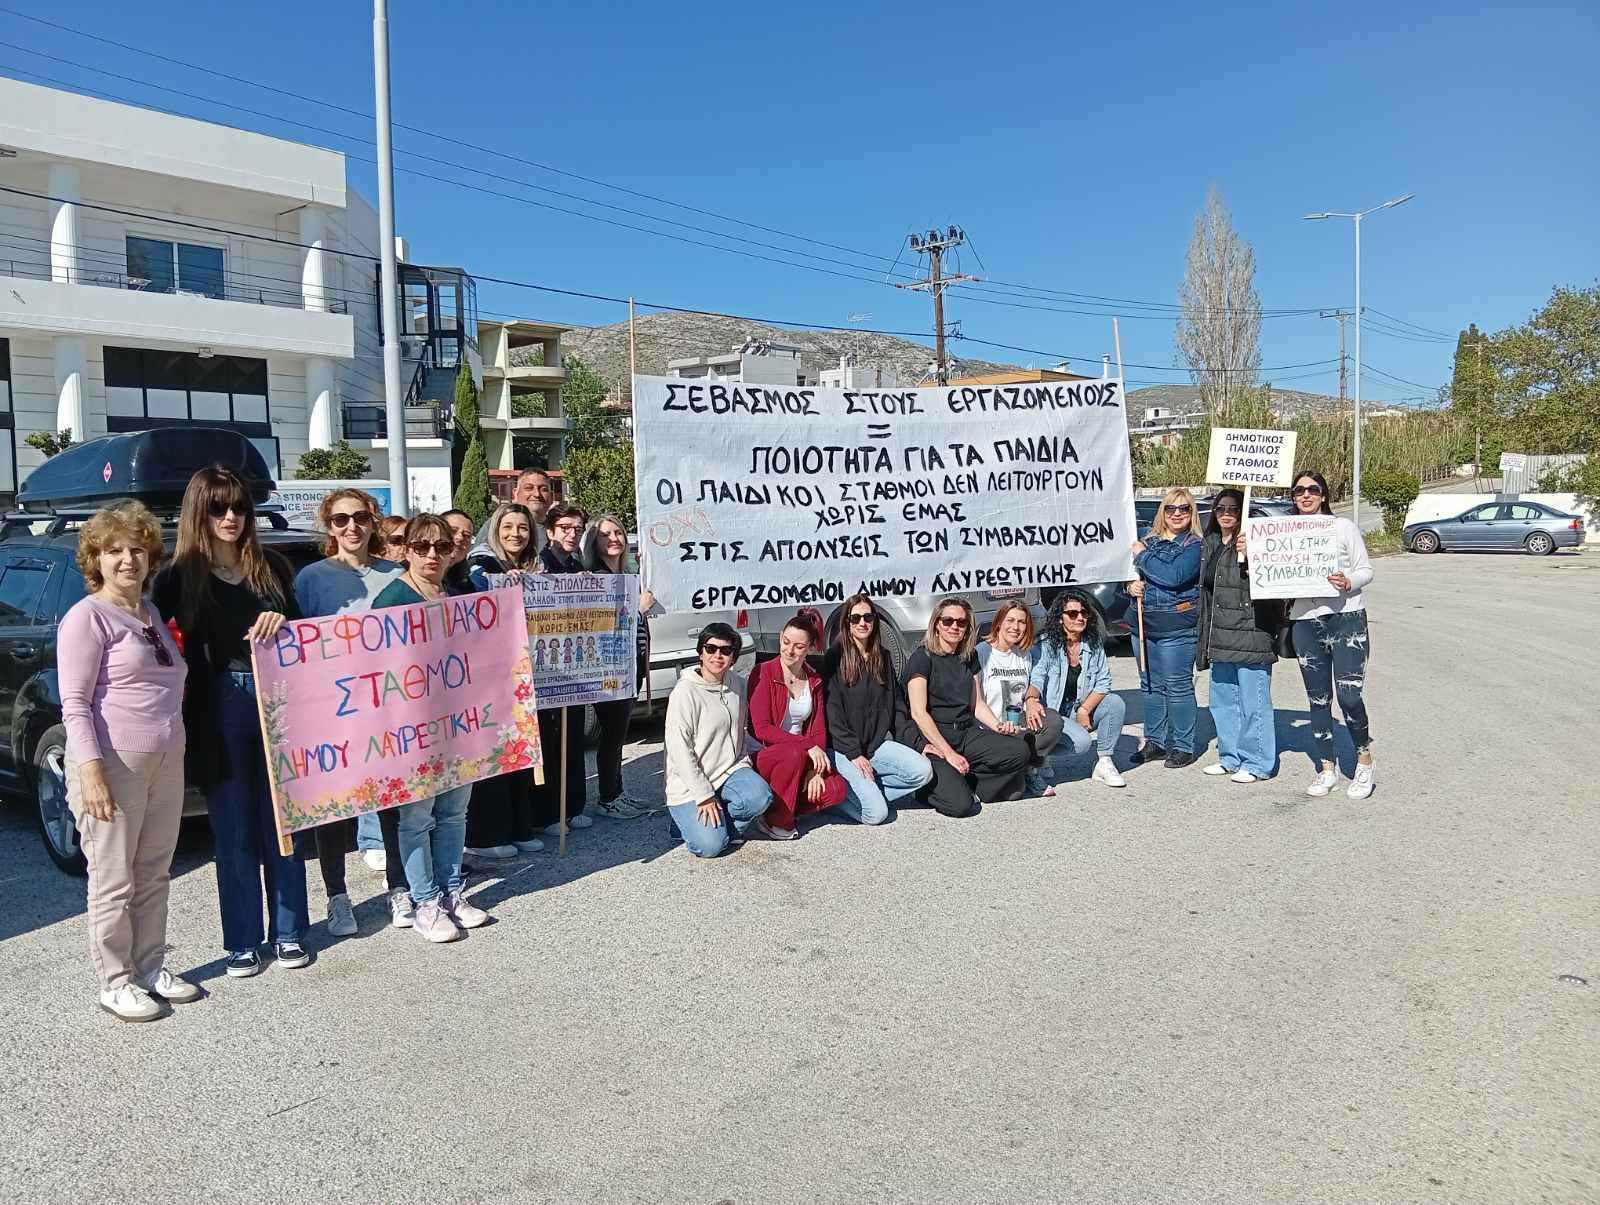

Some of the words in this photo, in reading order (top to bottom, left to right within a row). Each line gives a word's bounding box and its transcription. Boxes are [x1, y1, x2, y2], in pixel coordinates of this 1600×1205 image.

[663, 384, 820, 415] ΣΕΒΑΣΜΟΣ
[843, 392, 924, 415] ΣΤΟΥΣ
[947, 383, 1119, 413] ΕΡΓΑΖΟΜΕΝΟΥΣ
[1225, 433, 1285, 444] ΔΗΜΟΤΙΚΟΣ
[1229, 444, 1281, 455] ΠΑΙΔΙΚΟΣ
[750, 446, 893, 474] ΠΟΙΟΤΗΤΑ
[904, 445, 945, 472] ΓΙΑ
[948, 443, 984, 467] ΤΑ
[993, 435, 1079, 463] ΠΑΙΔΙΑ
[1225, 457, 1280, 469] ΣΤΑΘΜΟΣ
[656, 478, 682, 505] ΟΙ
[696, 479, 826, 508] ΠΑΙΔΙΚΟΙ
[839, 478, 936, 501] ΣΤΑΘΜΟΙ
[943, 470, 980, 495] ΔΕΝ
[987, 466, 1104, 492] ΛΕΙΤΟΥΡΓΟΥΝ
[1222, 472, 1276, 484] ΚΕΡΑΤΕΑΣ
[814, 504, 886, 533] ΧΩΡΙΣ
[902, 502, 967, 523] ΕΜΑΣ
[679, 540, 749, 563] ΣΤΙΣ
[759, 534, 889, 563] ΑΠΟΛΥΣΕΙΣ
[904, 528, 949, 554] ΤΩΝ
[1252, 553, 1310, 565] ΑΠΟΛΥΣΗ
[1265, 537, 1294, 553] ΟΧΙ
[1299, 537, 1329, 550] ΣΤΗΝ
[530, 581, 549, 591] ΣΤΙΣ
[553, 577, 605, 591] ΑΠΟΛΥΣΕΙΣ
[691, 579, 845, 609] ΕΡΓΑΖΟΜΕΝΟΙ
[931, 564, 1078, 594] ΛΑΥΡΕΩΤΙΚΗΣ
[275, 595, 500, 667] ΒΡΕΦΟΝΗΠΙΑΚΟΙ
[335, 653, 472, 716] ΣΤΑΘΜΟΙ
[276, 740, 348, 784] ΔΗΜΟΥ
[364, 703, 497, 763] ΛΑΥΡΕΩΤΙΚΗΣ
